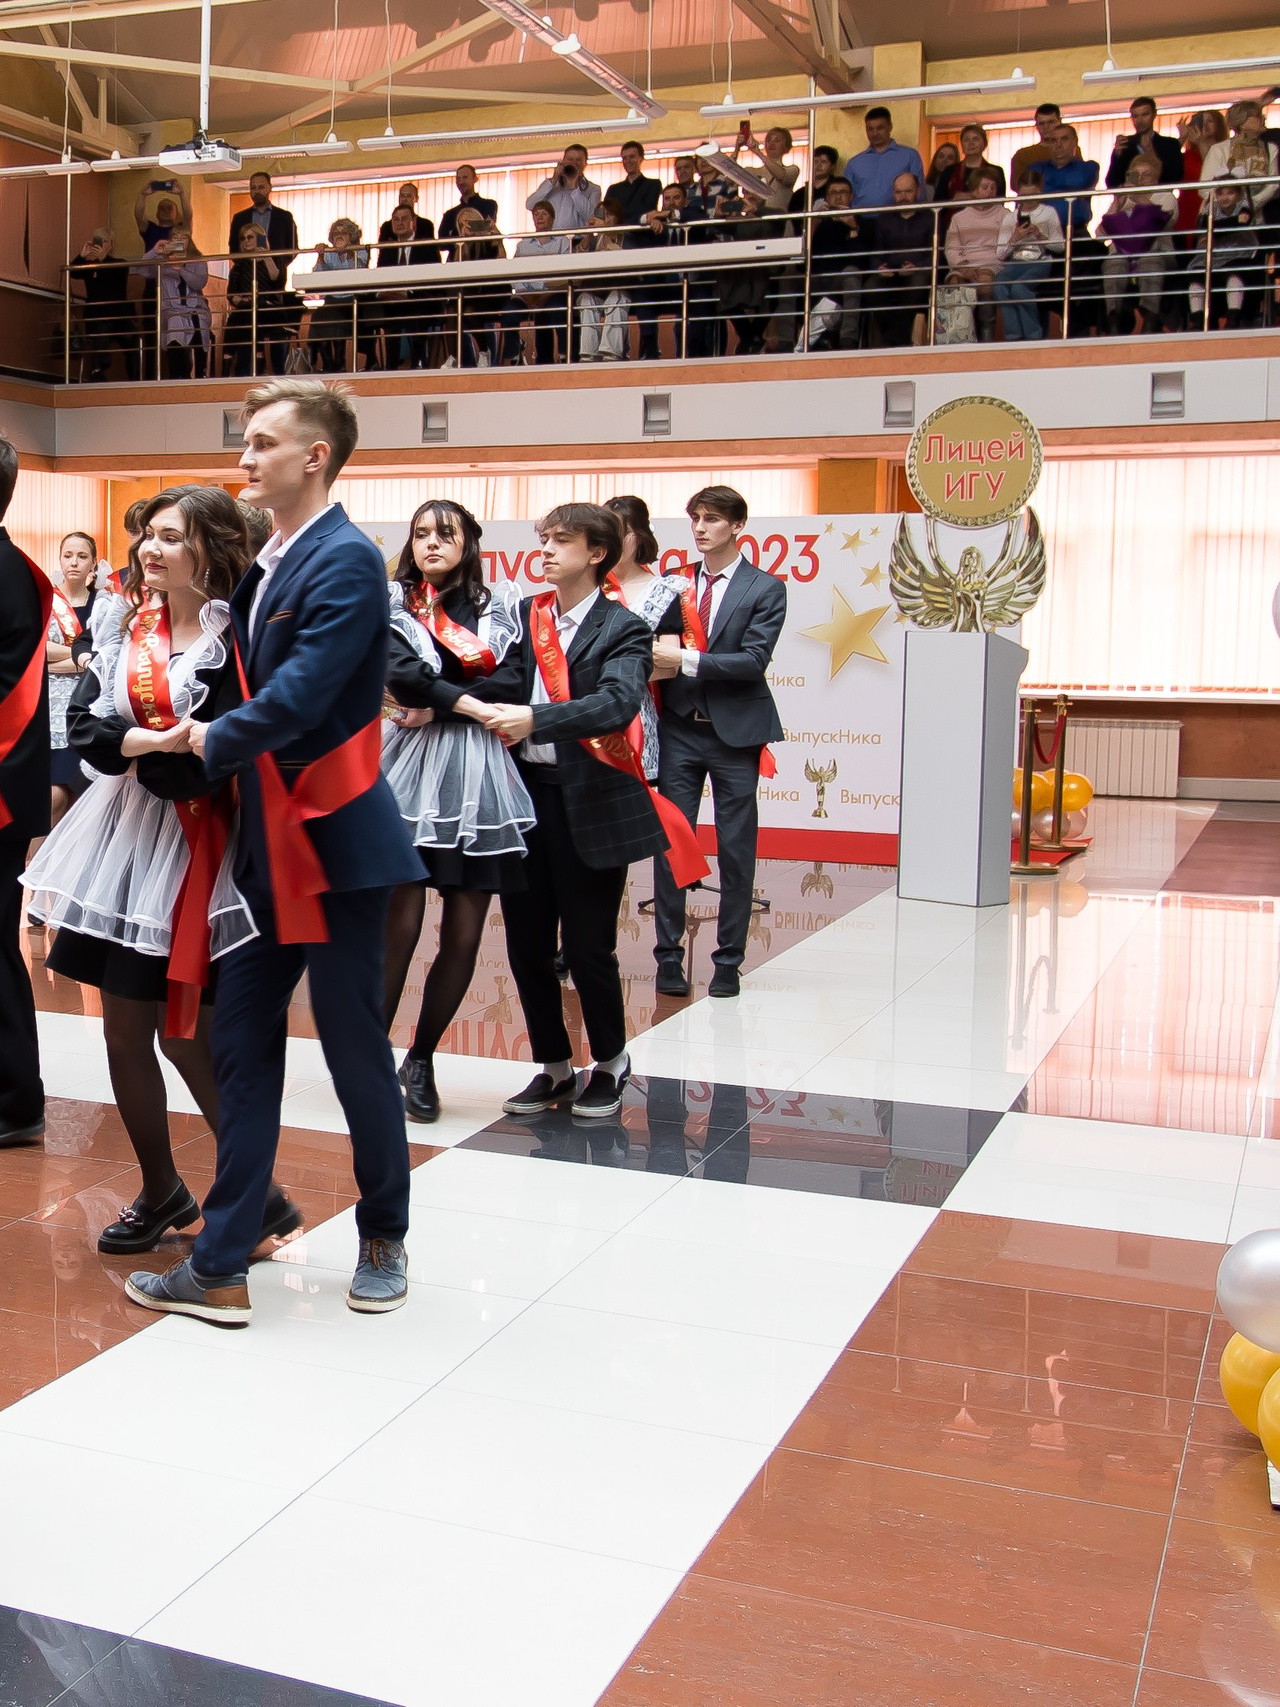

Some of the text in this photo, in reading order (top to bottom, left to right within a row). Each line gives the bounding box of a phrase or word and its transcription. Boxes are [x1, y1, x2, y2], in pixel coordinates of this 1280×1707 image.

[924, 431, 1026, 466] Лицей
[945, 471, 1006, 503] ИГУ
[736, 534, 820, 583] 023
[766, 672, 806, 688] Ника
[782, 727, 882, 748] ВыпускНика
[840, 789, 900, 810] Выпуск
